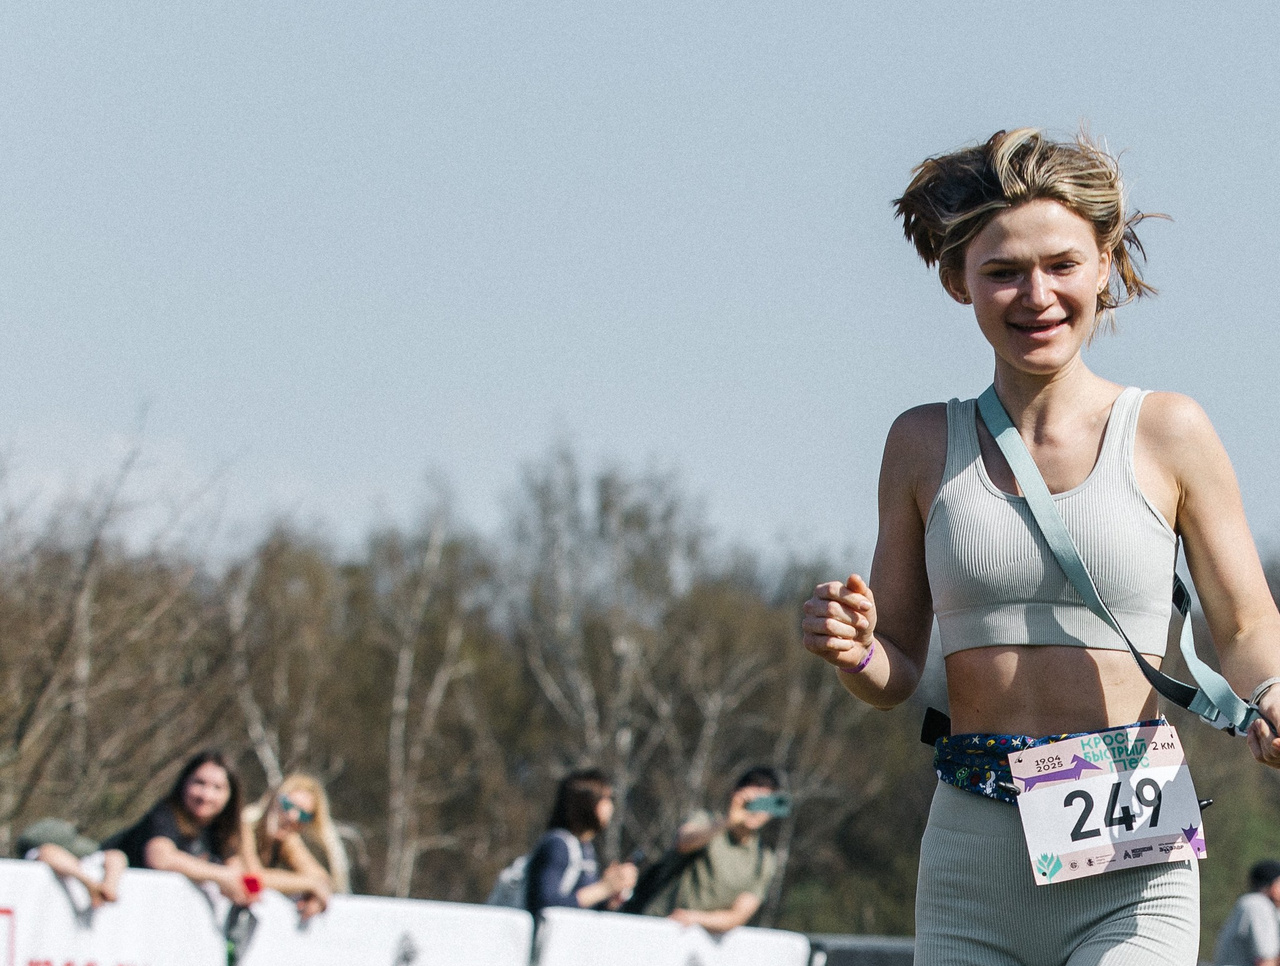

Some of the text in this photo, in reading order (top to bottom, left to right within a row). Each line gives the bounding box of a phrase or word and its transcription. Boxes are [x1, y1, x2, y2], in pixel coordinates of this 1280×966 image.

[1080, 732, 1131, 751] КРОСС
[1151, 741, 1159, 751] 2
[1035, 754, 1061, 767] 19.04
[1036, 761, 1064, 773] 2025
[1063, 777, 1162, 842] 249
